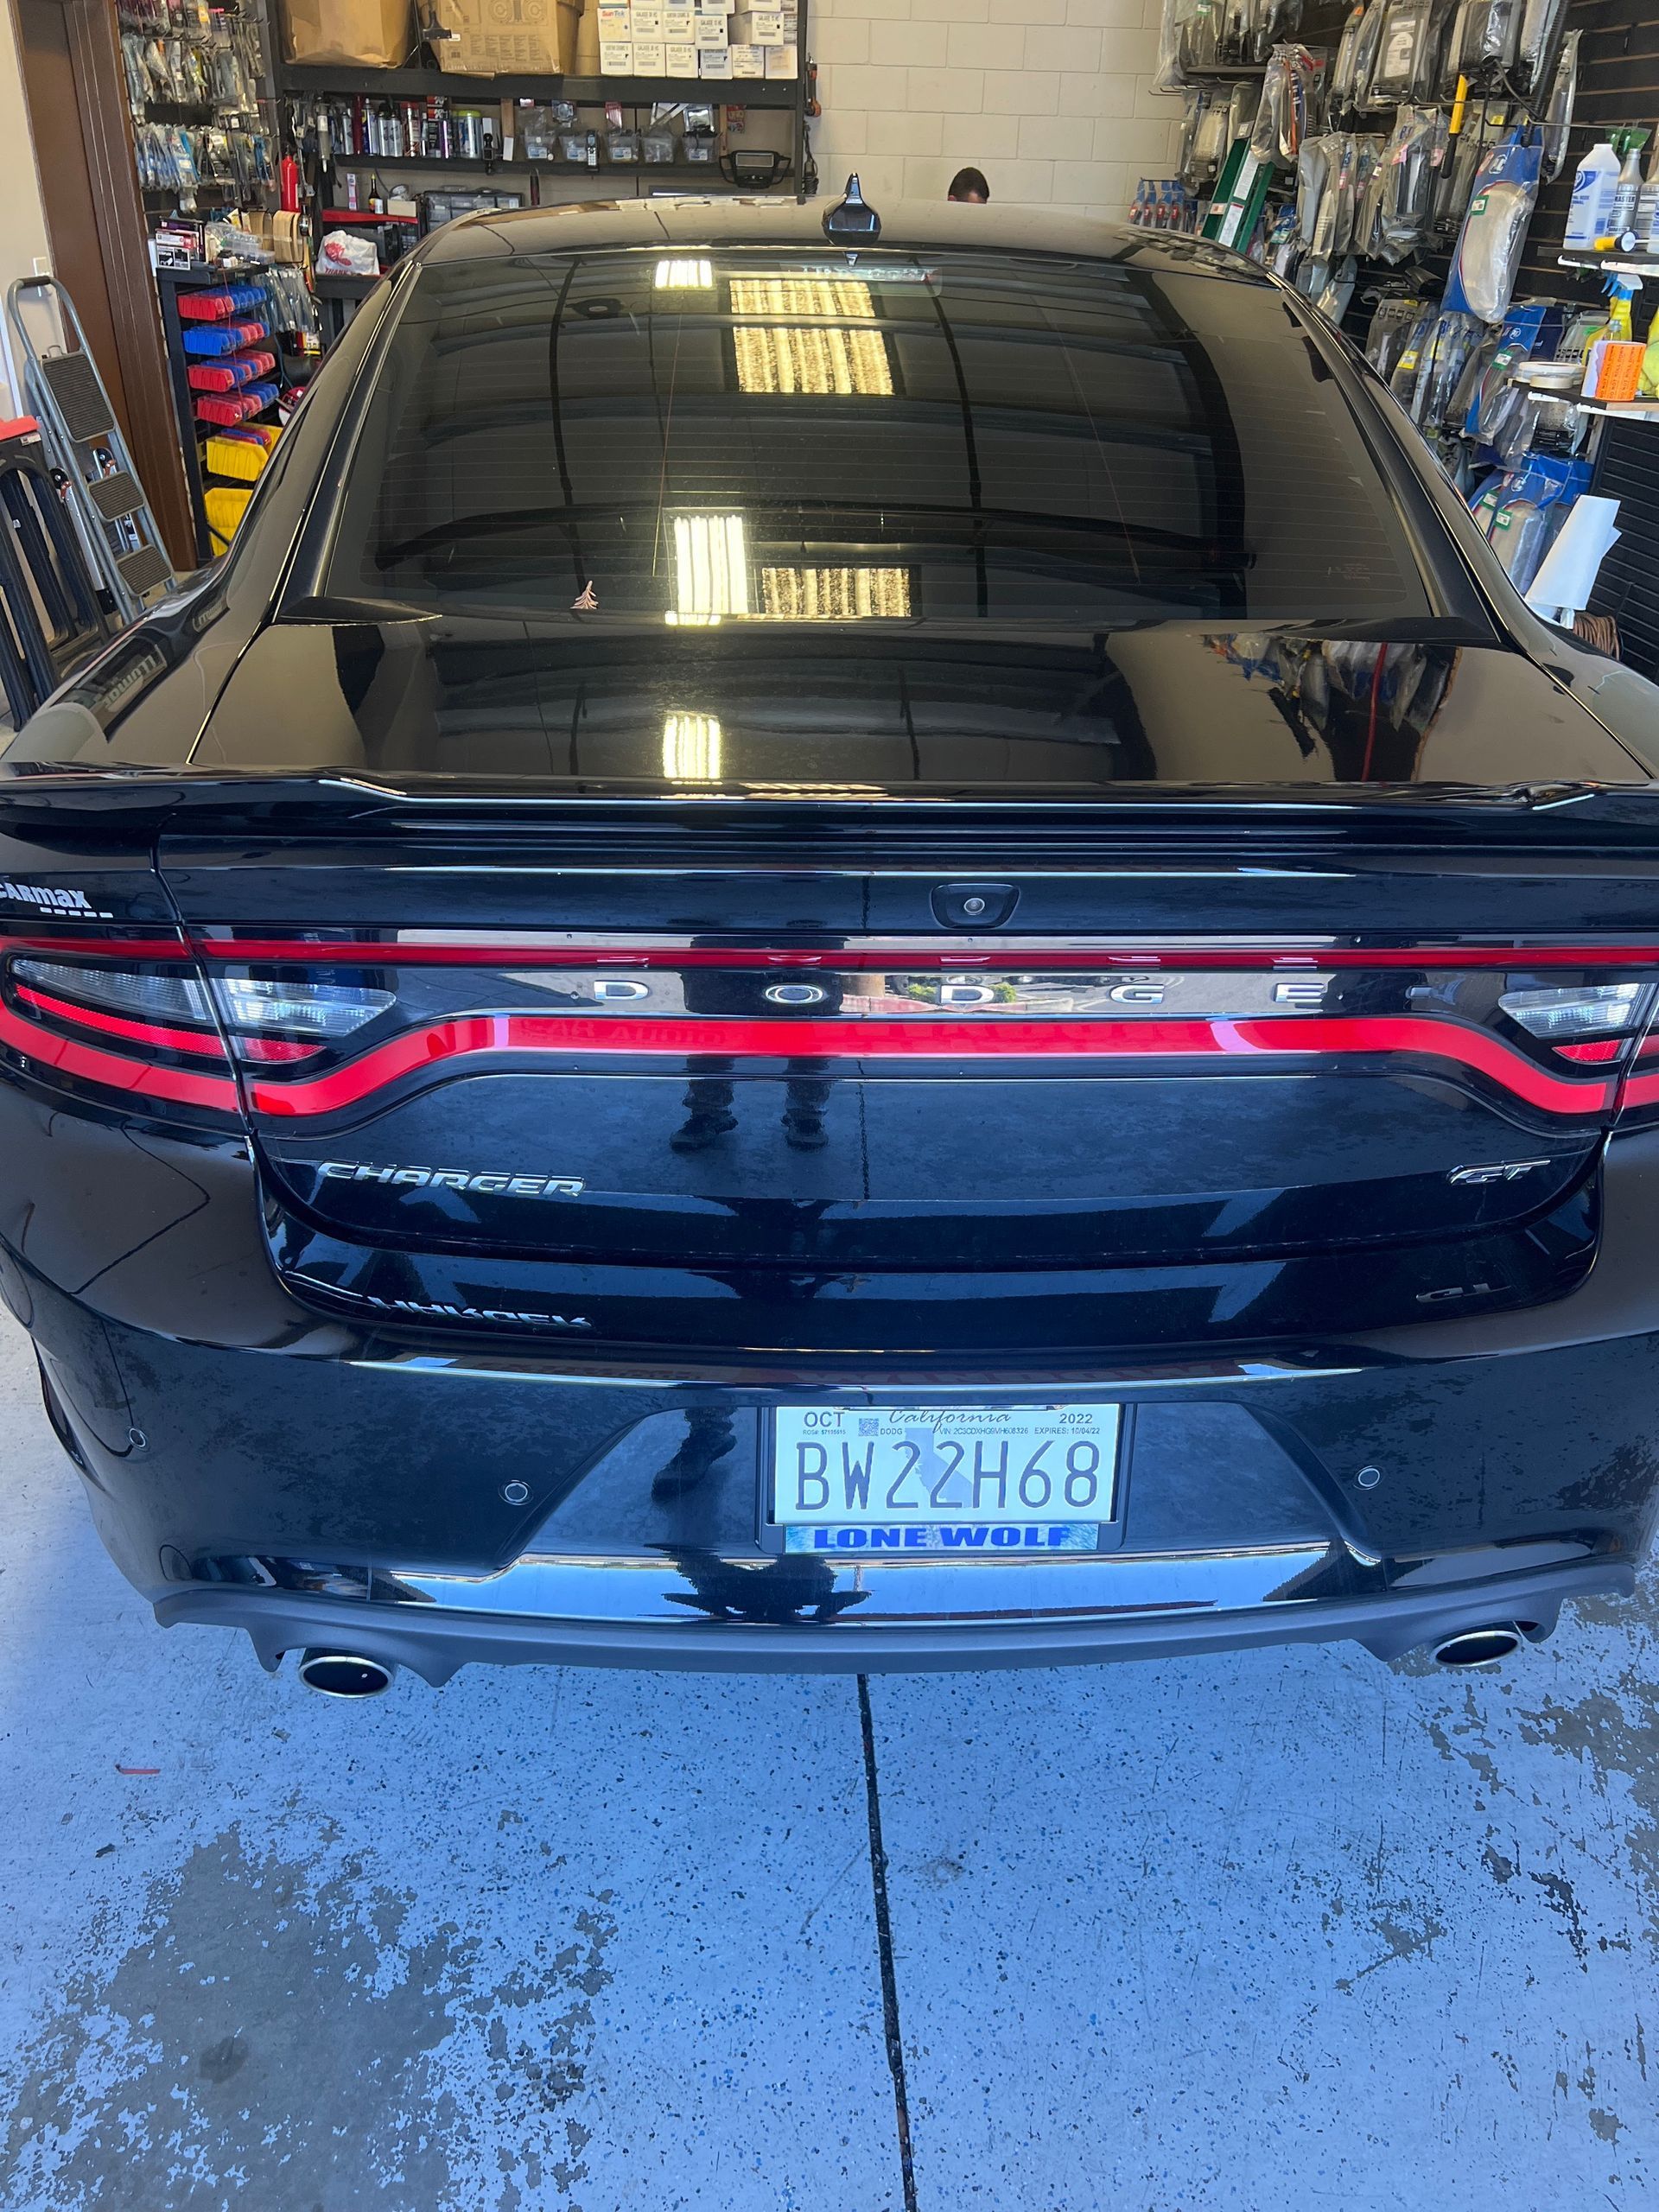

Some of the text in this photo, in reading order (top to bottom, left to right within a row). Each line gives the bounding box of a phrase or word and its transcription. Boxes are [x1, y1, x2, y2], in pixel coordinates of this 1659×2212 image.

[594, 981, 1325, 1005] DODGE
[317, 1160, 584, 1197] CHARGER
[1446, 1160, 1551, 1185] GT
[804, 1409, 1093, 1433] OCT California 2022
[795, 1440, 1100, 1510] BW22H68
[814, 1527, 1070, 1550] LONE WOLF
